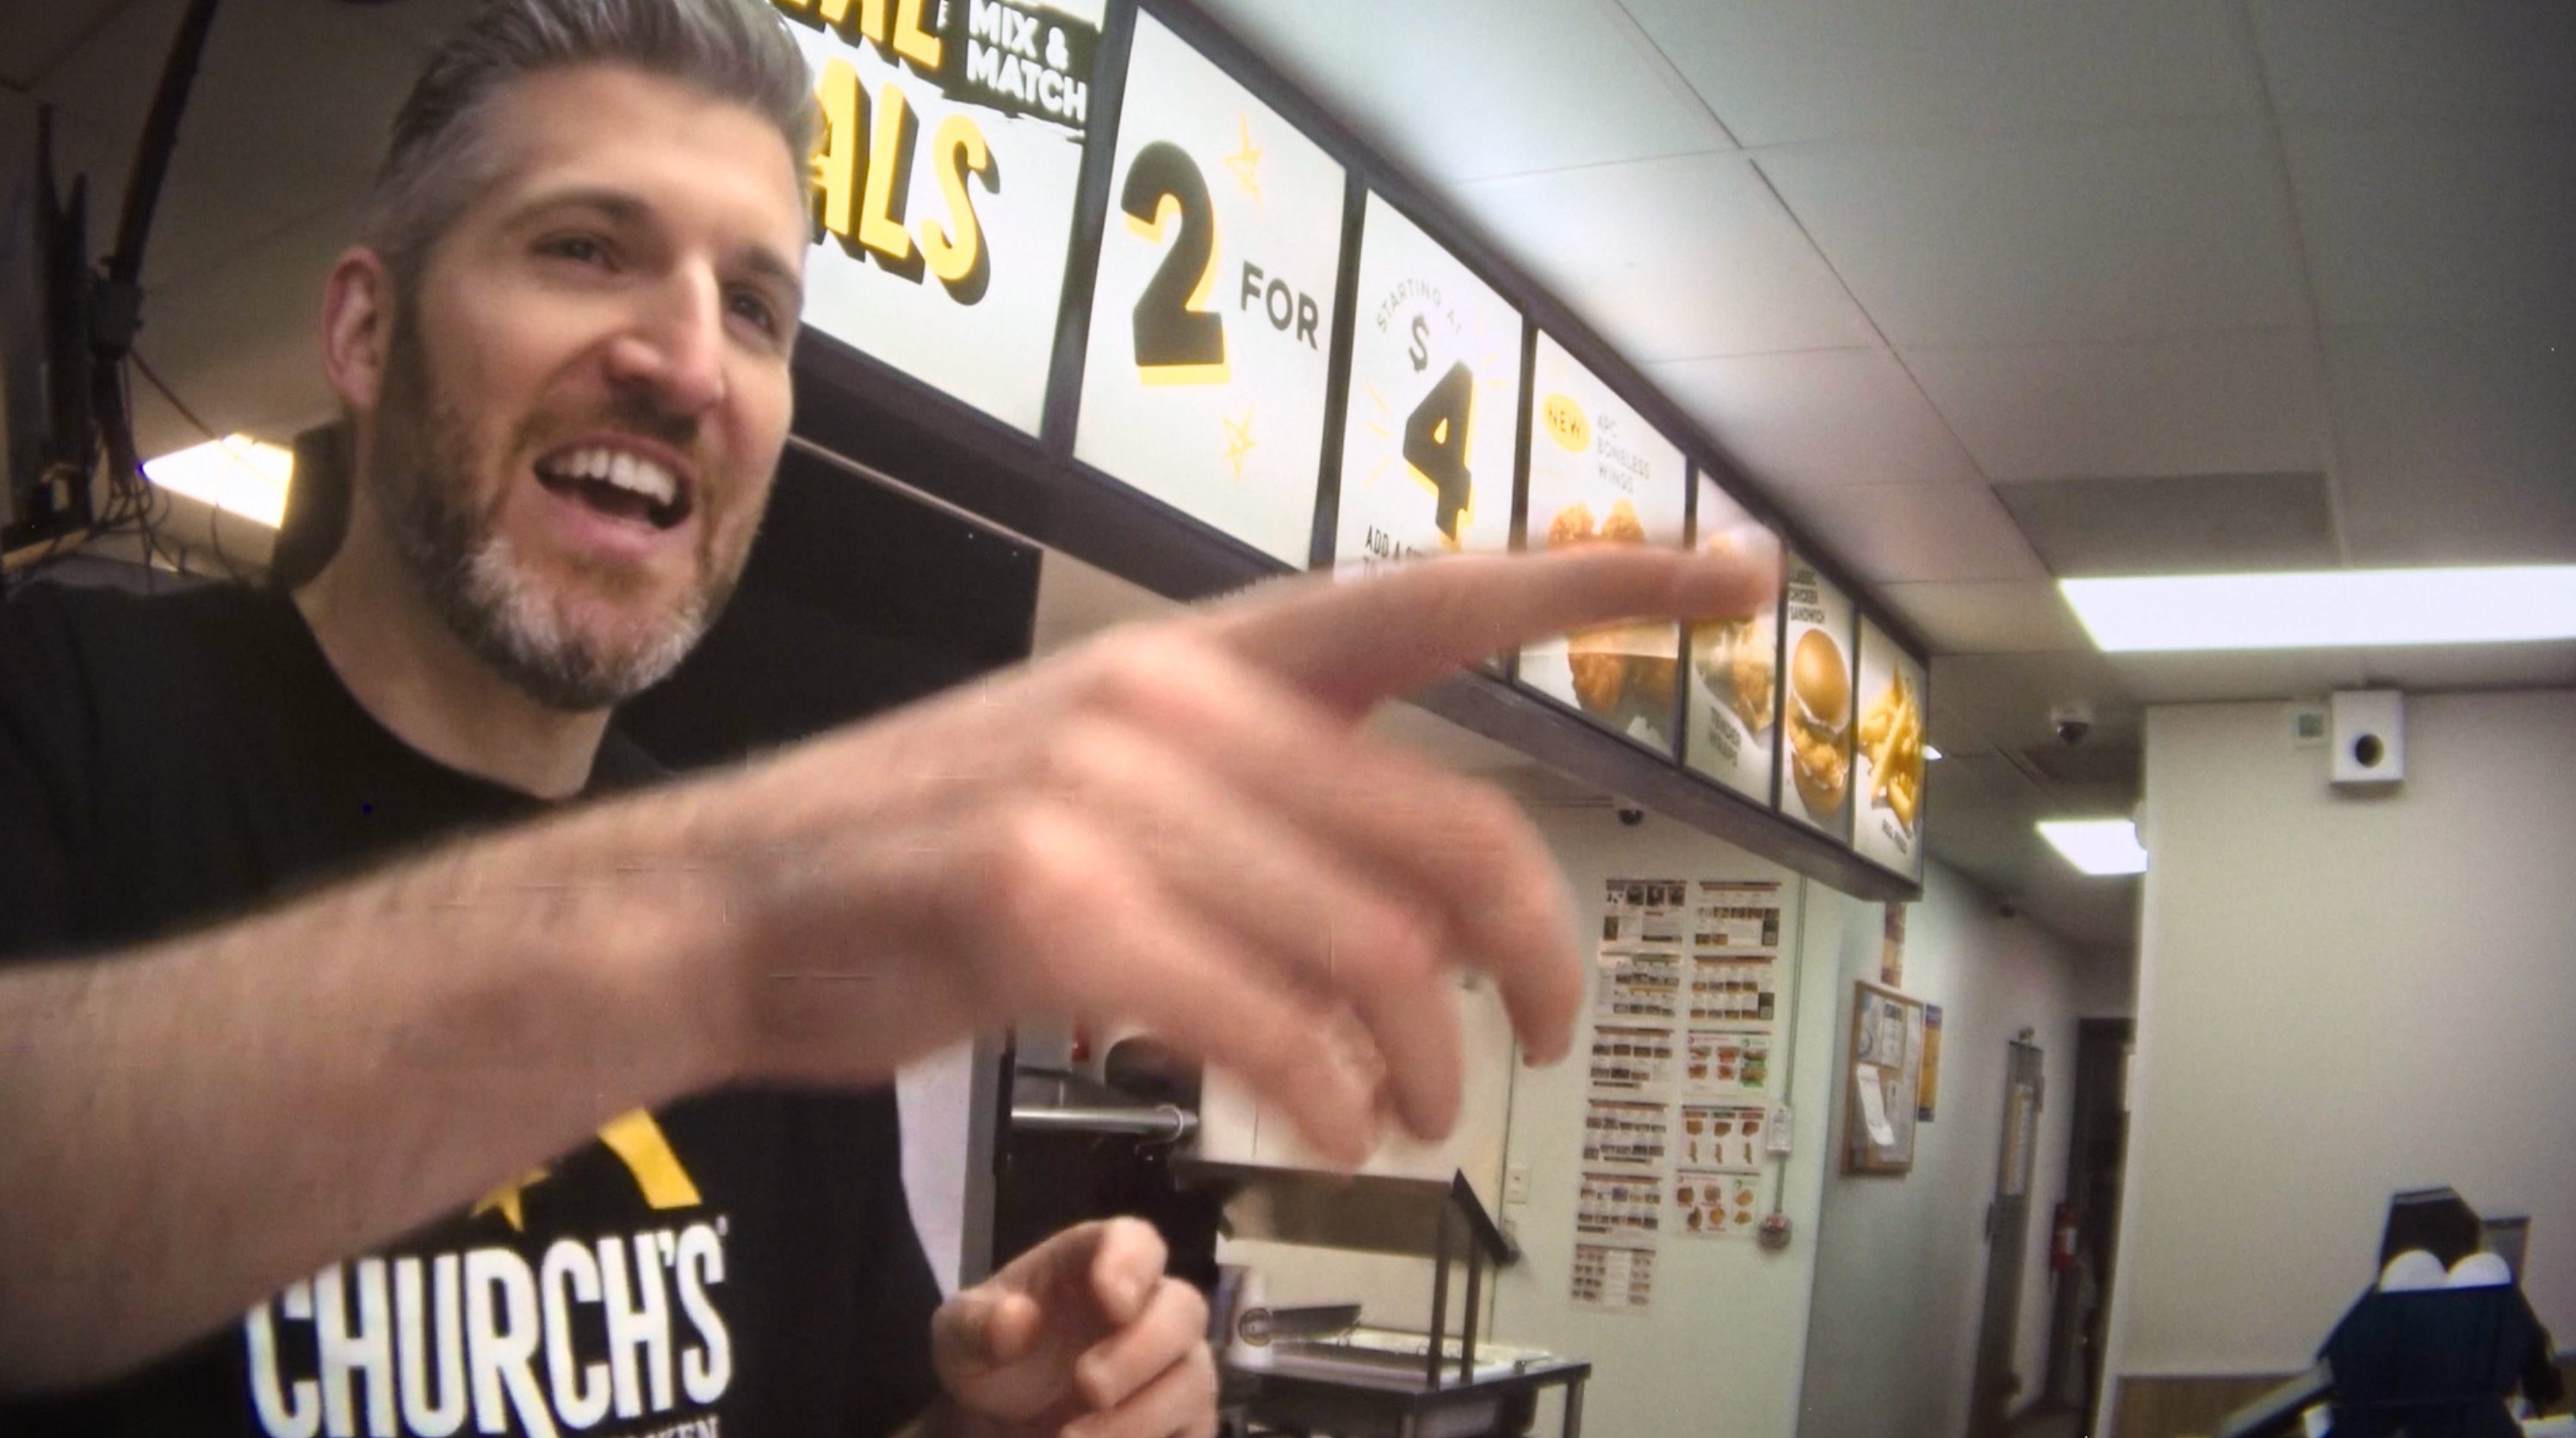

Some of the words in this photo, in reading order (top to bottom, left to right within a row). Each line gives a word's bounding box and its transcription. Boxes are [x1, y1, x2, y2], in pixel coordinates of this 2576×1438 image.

[969, 0, 1038, 59] MIX
[1045, 27, 1069, 70] &
[967, 39, 1087, 122] MATCH
[1121, 140, 1228, 385] 2
[1240, 260, 1319, 350] FOR
[1377, 278, 1442, 334] STARTING
[1403, 358, 1475, 548] 4
[1548, 406, 1582, 441] NEW
[1597, 435, 1650, 480] BONELESS
[1598, 463, 1634, 494] WINGS
[1365, 524, 1390, 560] ADD
[247, 1224, 732, 1438] CHURCH'S
